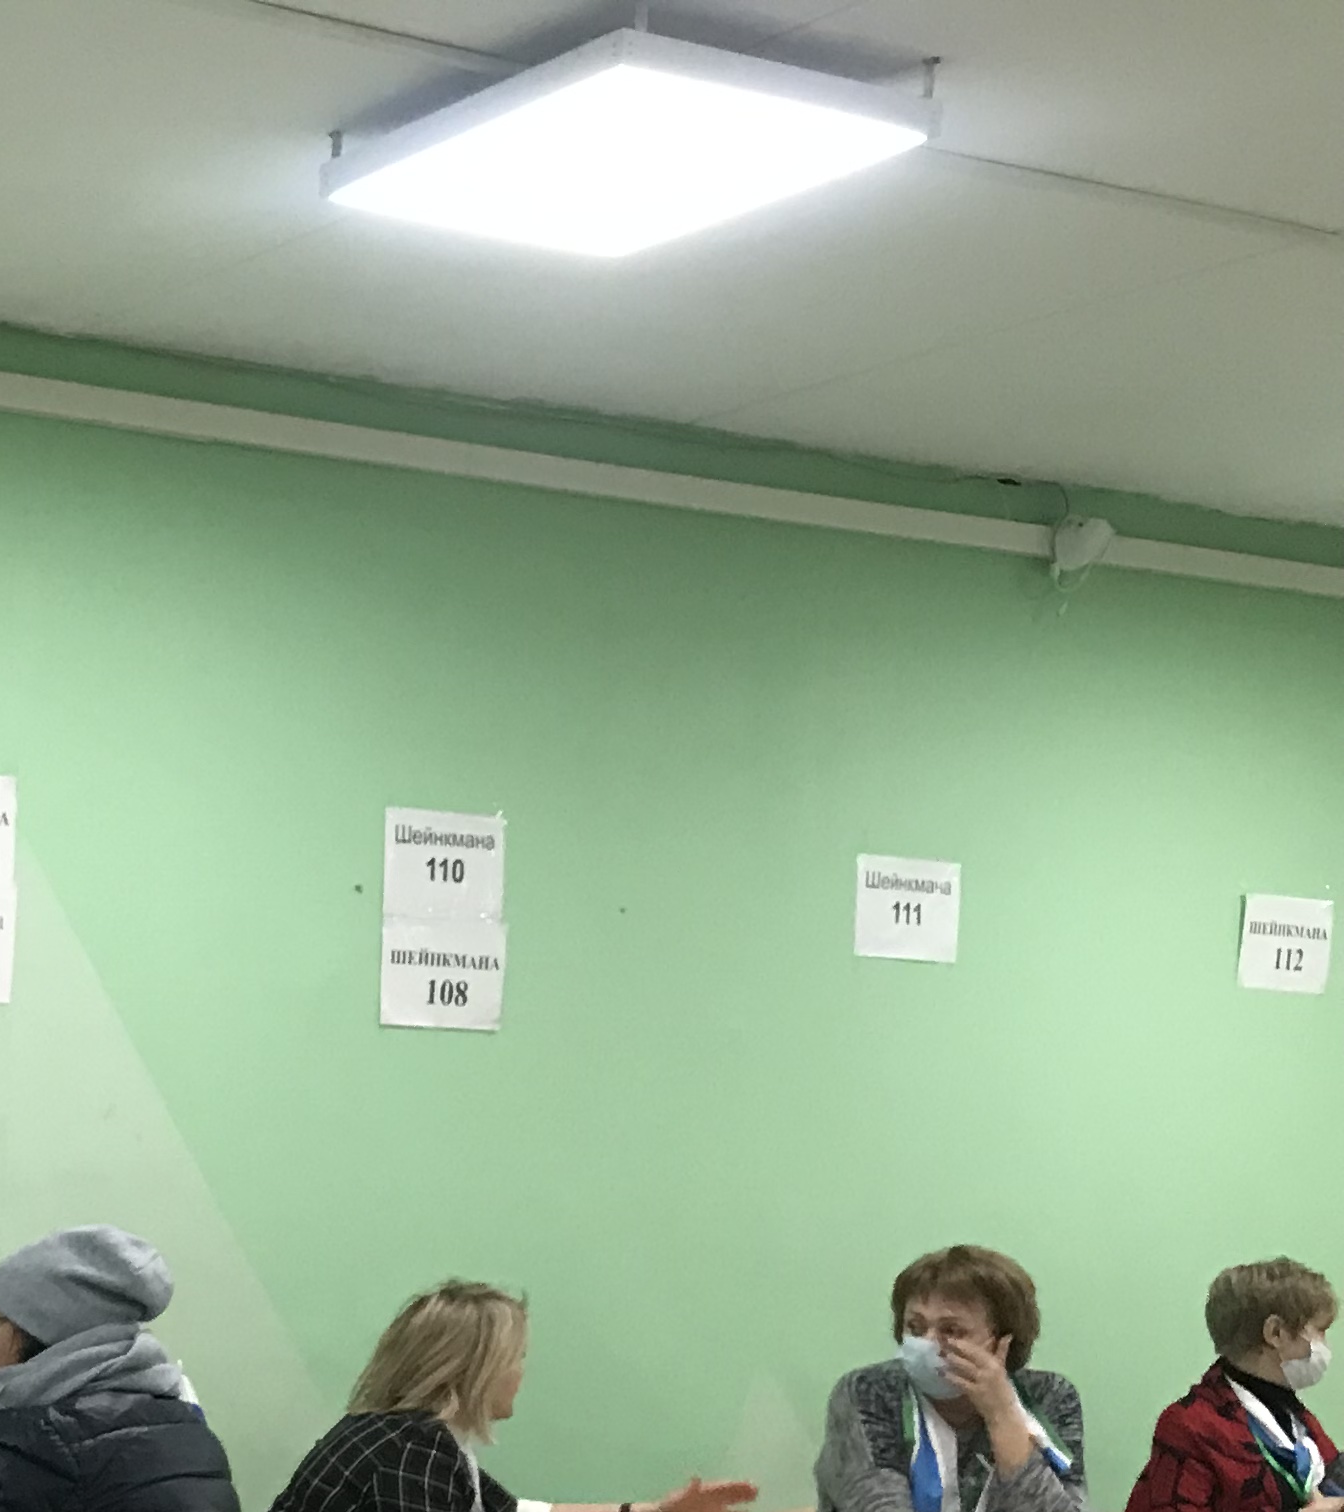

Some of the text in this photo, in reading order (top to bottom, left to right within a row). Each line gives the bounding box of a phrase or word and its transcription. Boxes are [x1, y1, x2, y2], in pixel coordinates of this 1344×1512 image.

[394, 824, 496, 850] Шейнкмана
[426, 857, 465, 883] 110
[892, 900, 921, 926] 111
[391, 948, 500, 972] ШЕЙНКМАНА
[1274, 947, 1304, 972] 112
[426, 979, 469, 1007] 108
